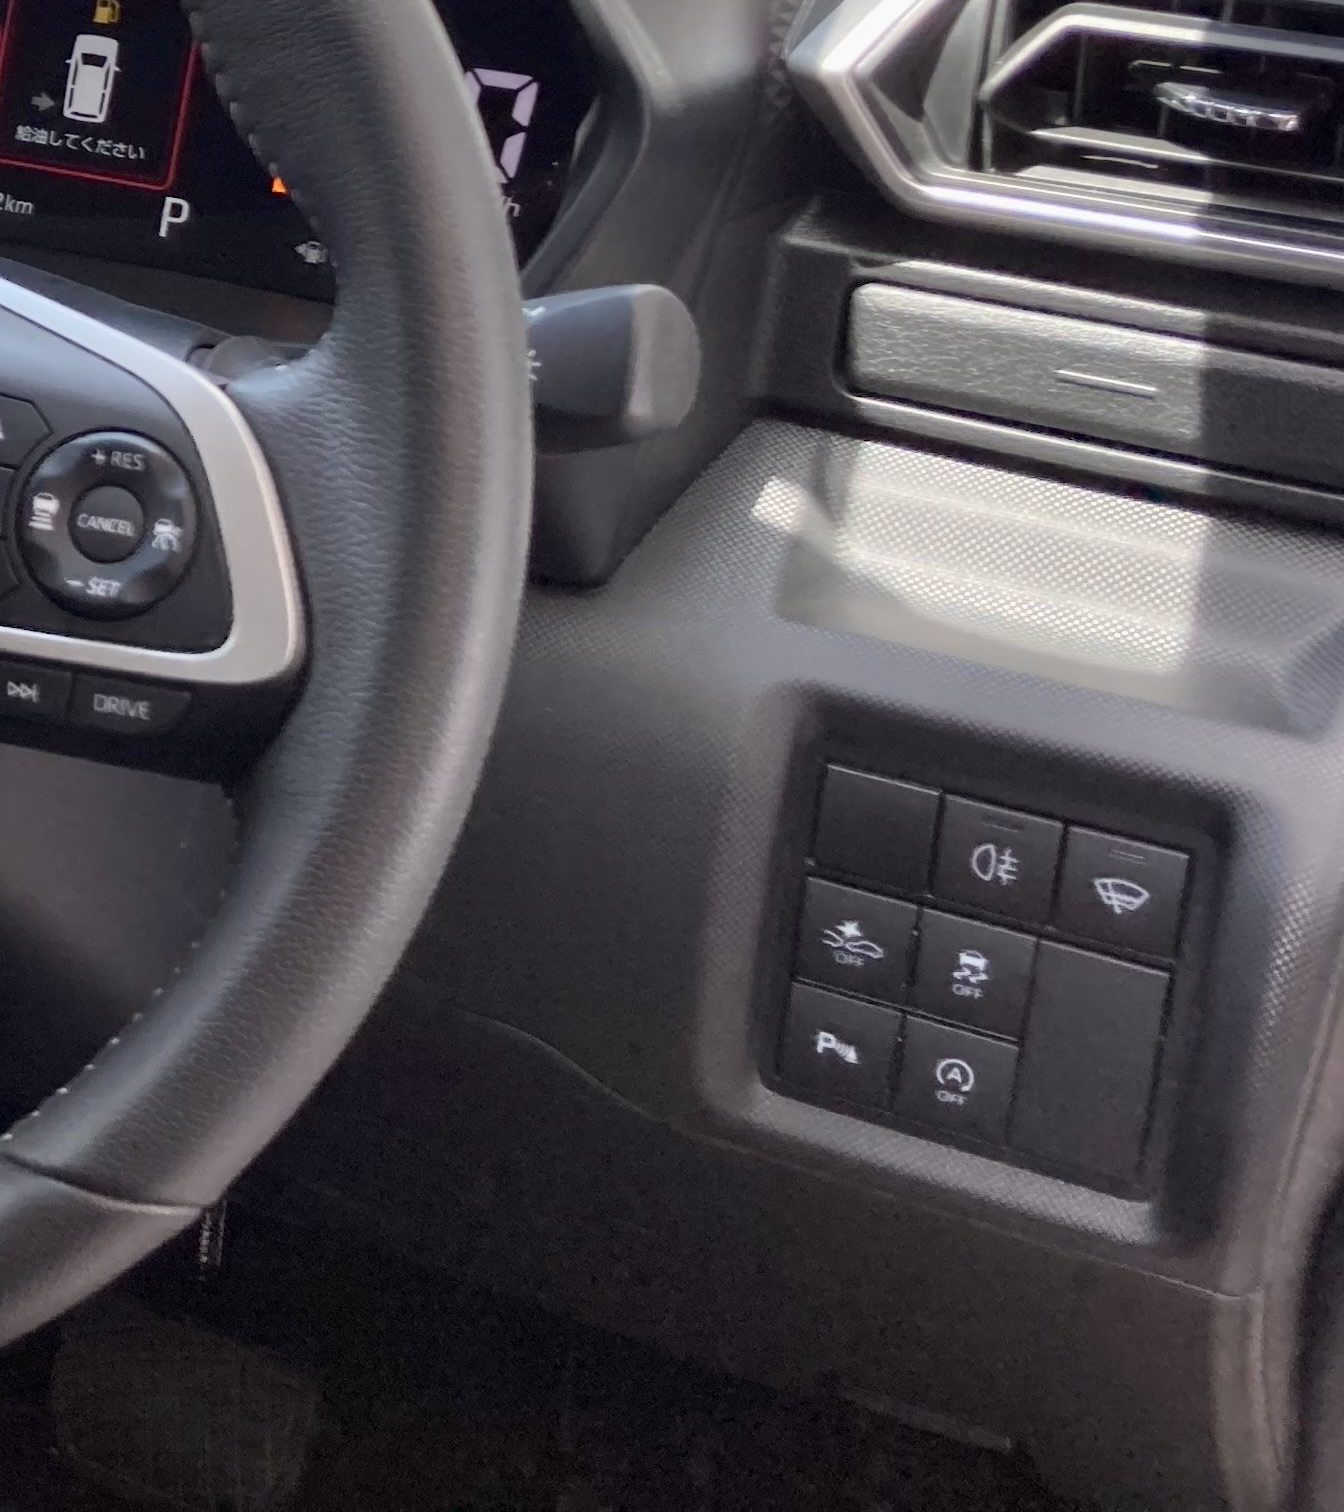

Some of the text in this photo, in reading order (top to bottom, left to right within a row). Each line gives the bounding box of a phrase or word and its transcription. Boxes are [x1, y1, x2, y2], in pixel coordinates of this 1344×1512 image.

[14, 124, 146, 161] 給油してください
[159, 196, 190, 238] P
[75, 511, 137, 539] CANCEL
[92, 693, 153, 722] DRIVE
